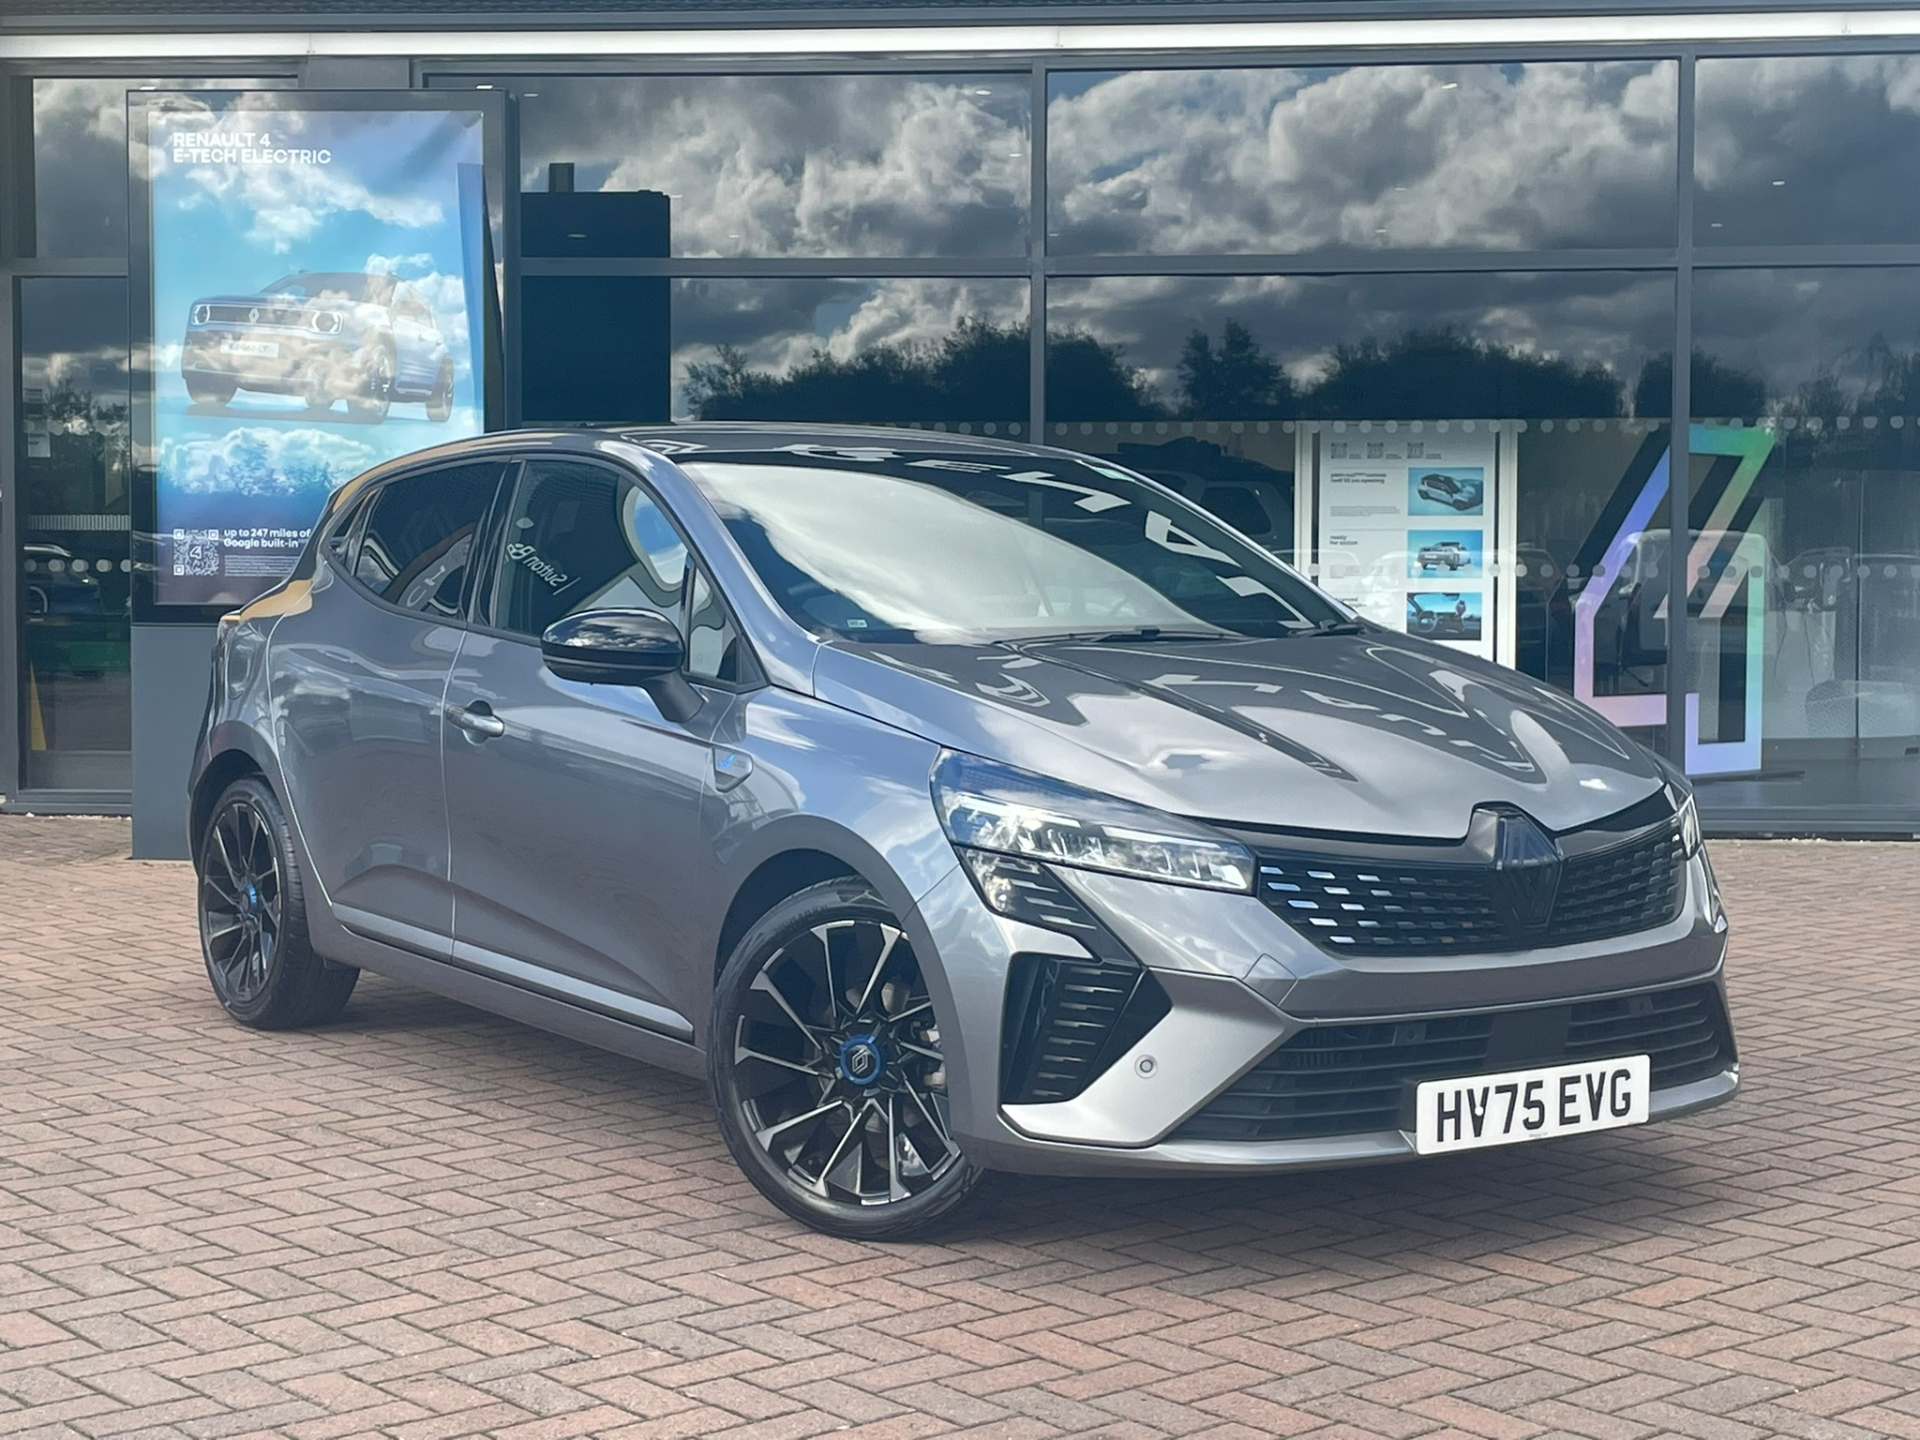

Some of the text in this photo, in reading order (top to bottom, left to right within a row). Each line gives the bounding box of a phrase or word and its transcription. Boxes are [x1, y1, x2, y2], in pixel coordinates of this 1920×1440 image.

[173, 132, 271, 147] RENAULT 4
[173, 148, 332, 164] E-TECH ELECTRIC
[224, 528, 311, 539] up to 247 miles of
[223, 538, 260, 549] Google
[261, 538, 299, 548] built-in
[1437, 1068, 1632, 1142] HV75 EVG
